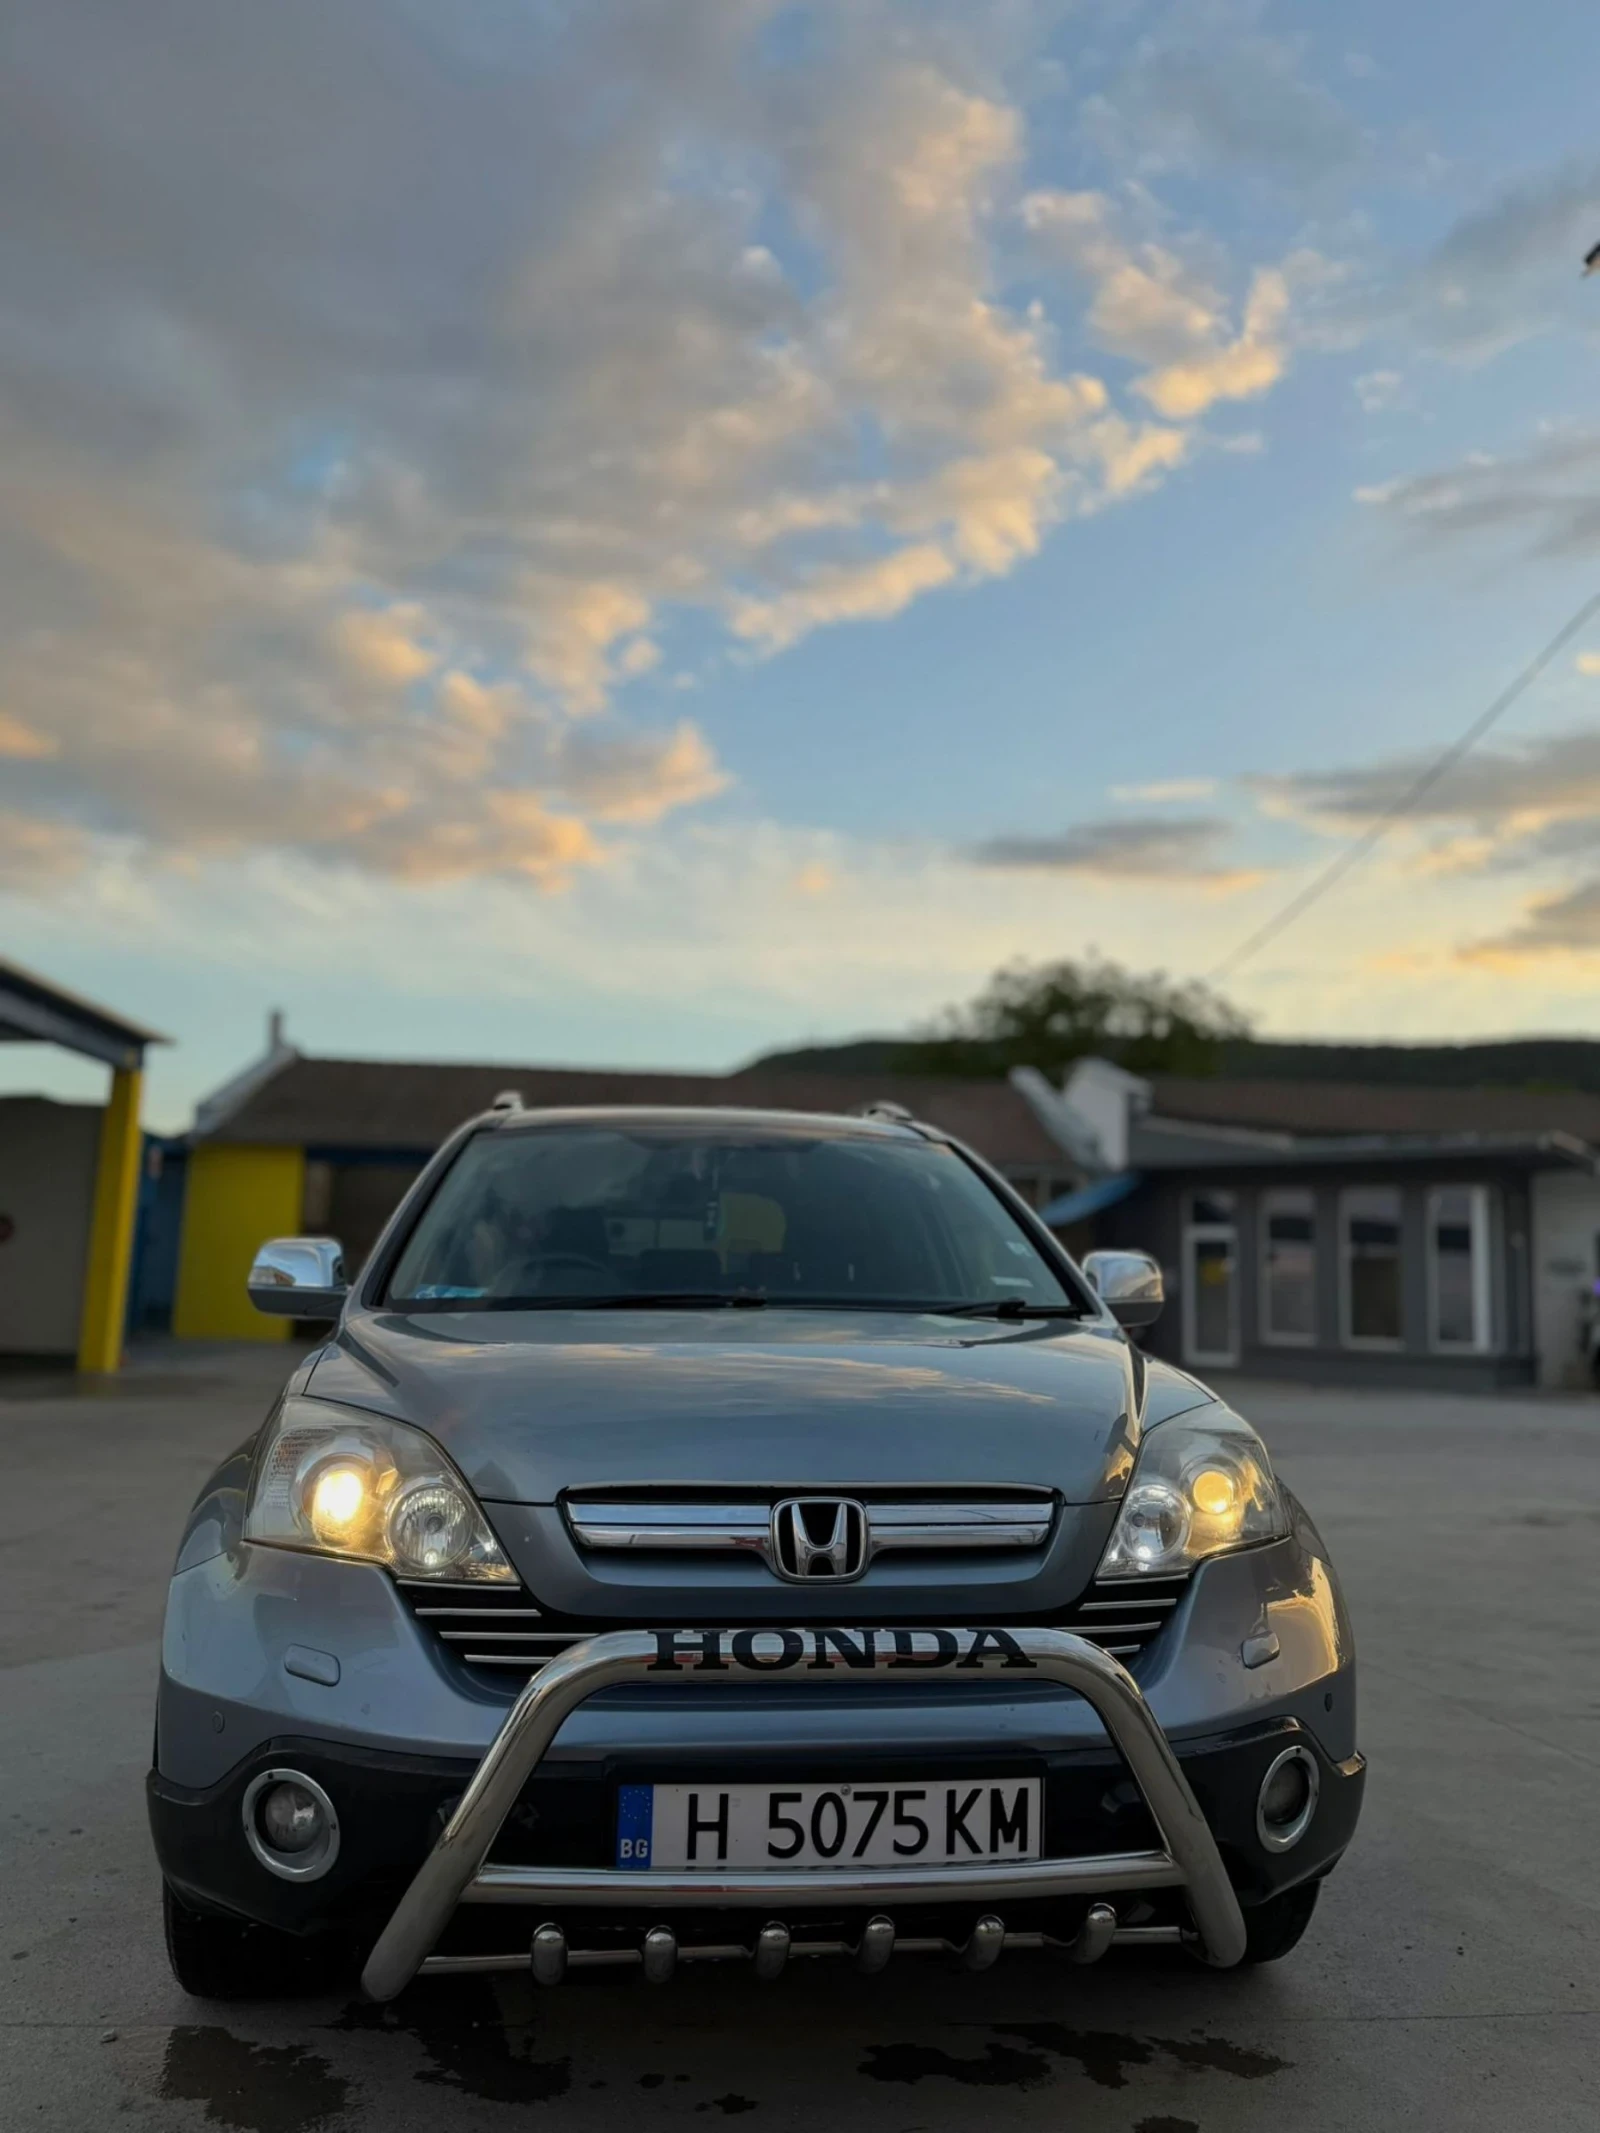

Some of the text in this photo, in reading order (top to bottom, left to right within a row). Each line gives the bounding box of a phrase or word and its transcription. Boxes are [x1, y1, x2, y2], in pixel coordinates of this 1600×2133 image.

[647, 1629, 1037, 1670] HONDA
[686, 1793, 730, 1860] H
[620, 1839, 649, 1859] BG
